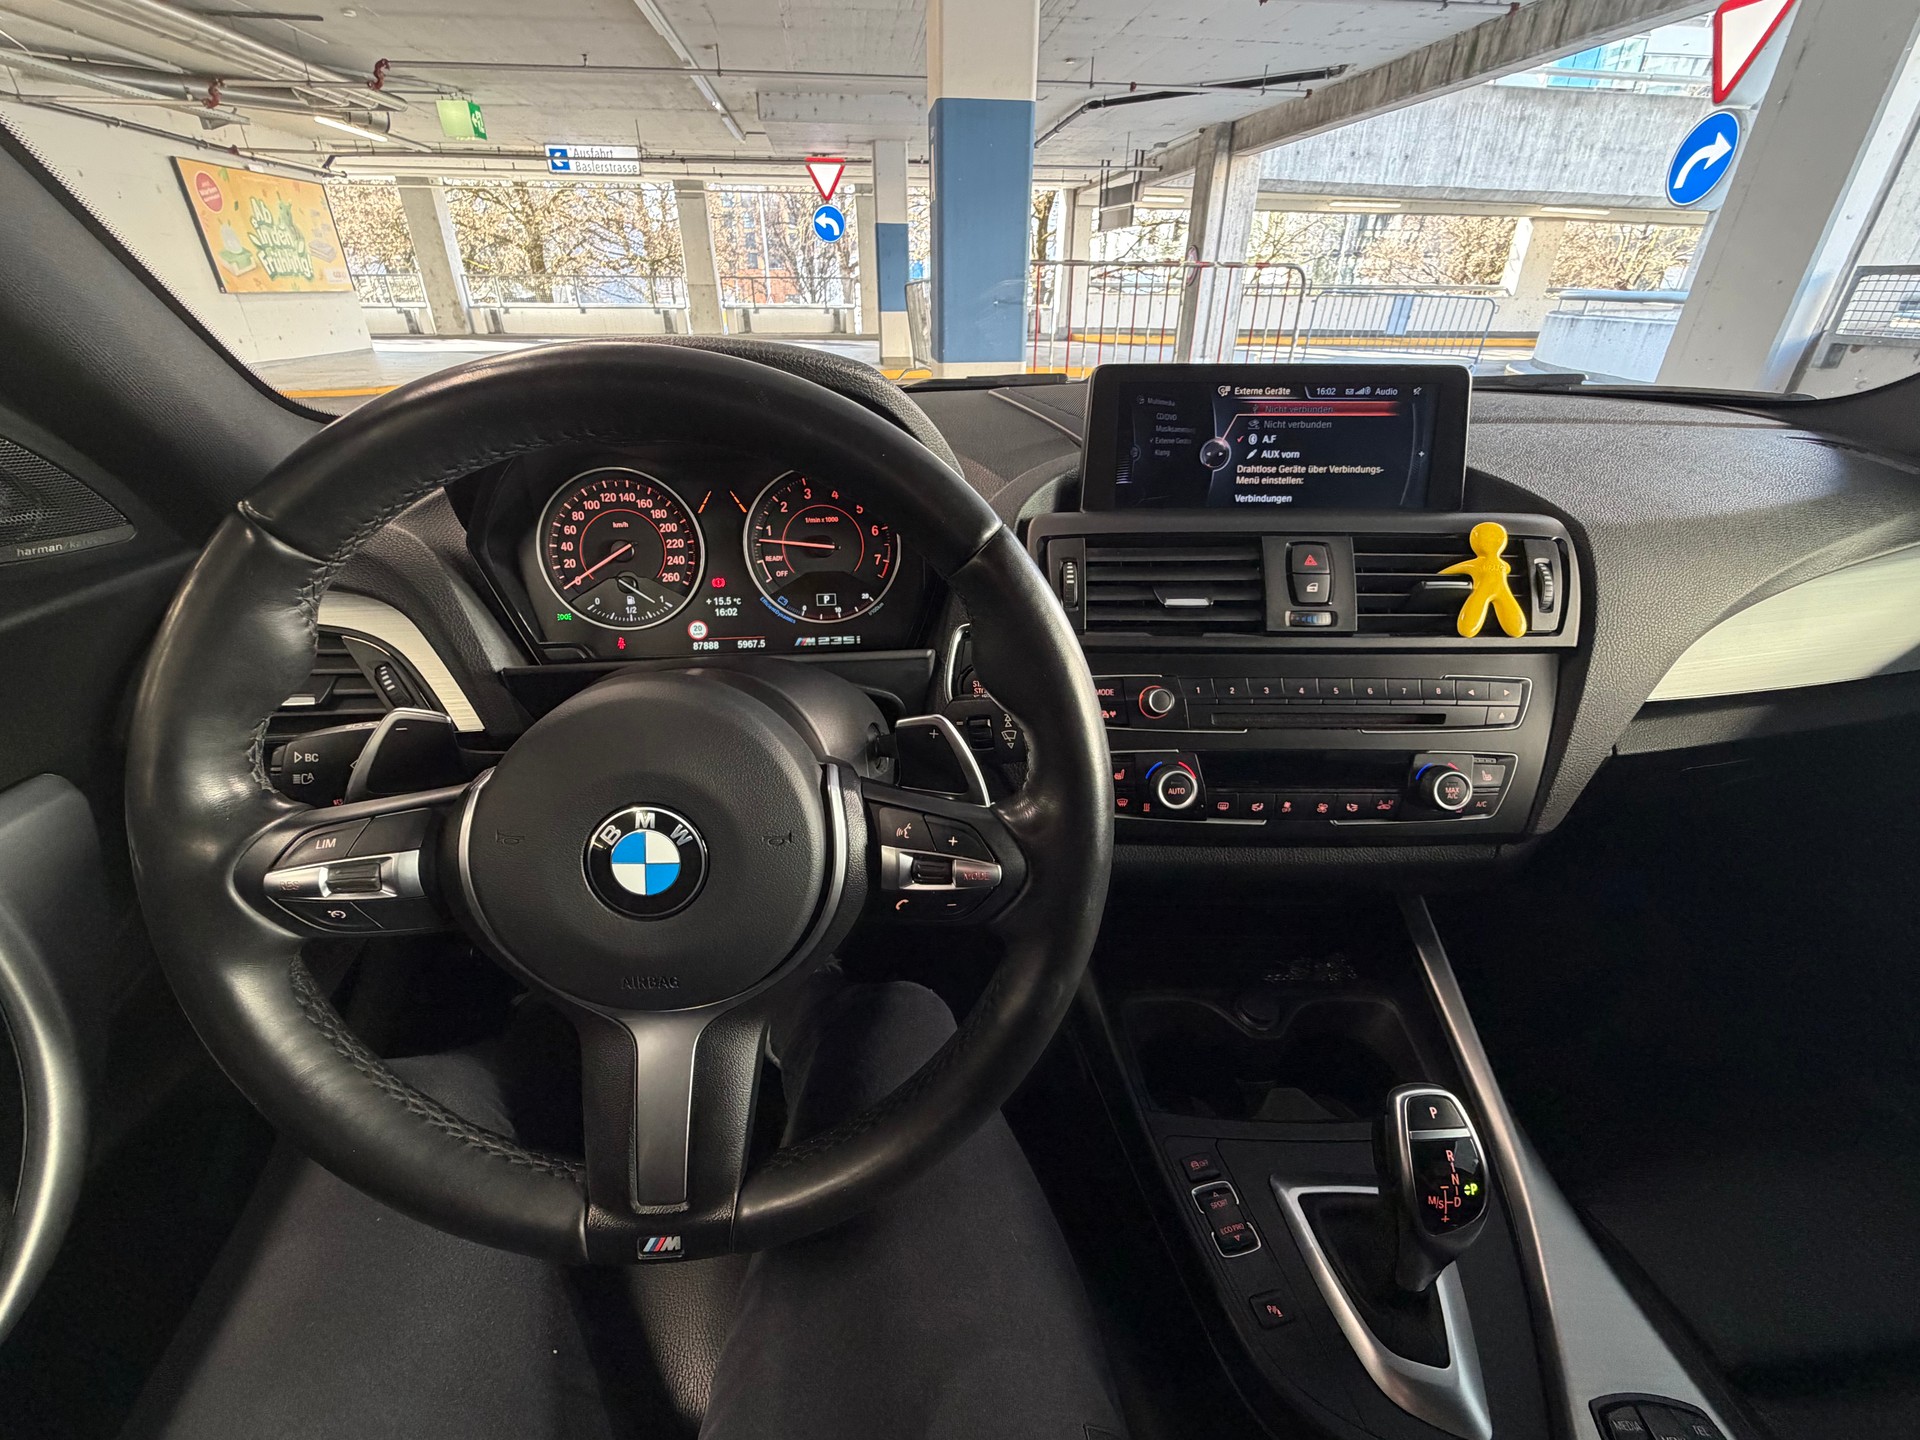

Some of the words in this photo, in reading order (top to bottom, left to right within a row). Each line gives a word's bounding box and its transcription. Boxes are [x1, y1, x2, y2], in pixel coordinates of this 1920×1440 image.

[573, 148, 613, 158] Ausfahrt
[575, 161, 637, 173] Baslerstrasse
[1234, 386, 1263, 395] Externe
[1264, 386, 1291, 395] Geräte
[1316, 387, 1337, 395] 16:02
[1375, 387, 1398, 396] Audio
[1263, 420, 1286, 429] Nicht
[1288, 420, 1332, 429] verbunden
[1261, 450, 1280, 458] AUX
[1236, 464, 1277, 473] Drahtlose
[1278, 464, 1306, 473] Geräte
[1308, 464, 1328, 473] über
[1329, 464, 1384, 475] Verbindungs-
[1236, 476, 1260, 484] Menü
[600, 493, 617, 502] 120
[618, 493, 636, 502] 140
[803, 488, 812, 499] 3
[831, 490, 839, 500] 4
[636, 499, 653, 509] 160
[1234, 494, 1292, 504] Verbindungen
[583, 501, 601, 510] 100
[780, 501, 788, 513] 2
[856, 504, 864, 514] 5
[571, 511, 585, 521] 80
[650, 509, 668, 519] 180
[563, 524, 577, 535] 60
[612, 521, 629, 529] km/h
[659, 523, 678, 533] 200
[766, 525, 772, 536] 1
[871, 525, 880, 537] 6
[560, 541, 574, 551] 40
[666, 539, 684, 549] 220
[563, 559, 576, 569] 20
[667, 555, 685, 566] 240
[764, 555, 784, 563] READY
[874, 553, 881, 565] 7
[662, 572, 680, 583] 260
[594, 597, 600, 605] 0
[714, 597, 732, 605] 15.5
[823, 595, 830, 604] P
[625, 606, 638, 614] 1/2
[715, 608, 738, 616] 16:02
[693, 642, 719, 650] 87888
[737, 640, 766, 648] 5967.5
[305, 754, 319, 762] BC
[600, 812, 693, 847] BMW
[316, 838, 336, 850] LIM
[621, 976, 680, 990] AIRBAG
[1429, 1107, 1437, 1119] P
[1446, 1150, 1454, 1161] R
[1452, 1173, 1460, 1185] N
[1210, 1199, 1228, 1209] SPORT
[1454, 1197, 1461, 1207] D
[1613, 1420, 1644, 1431] MEDIA
[1692, 1425, 1712, 1437] TEL
